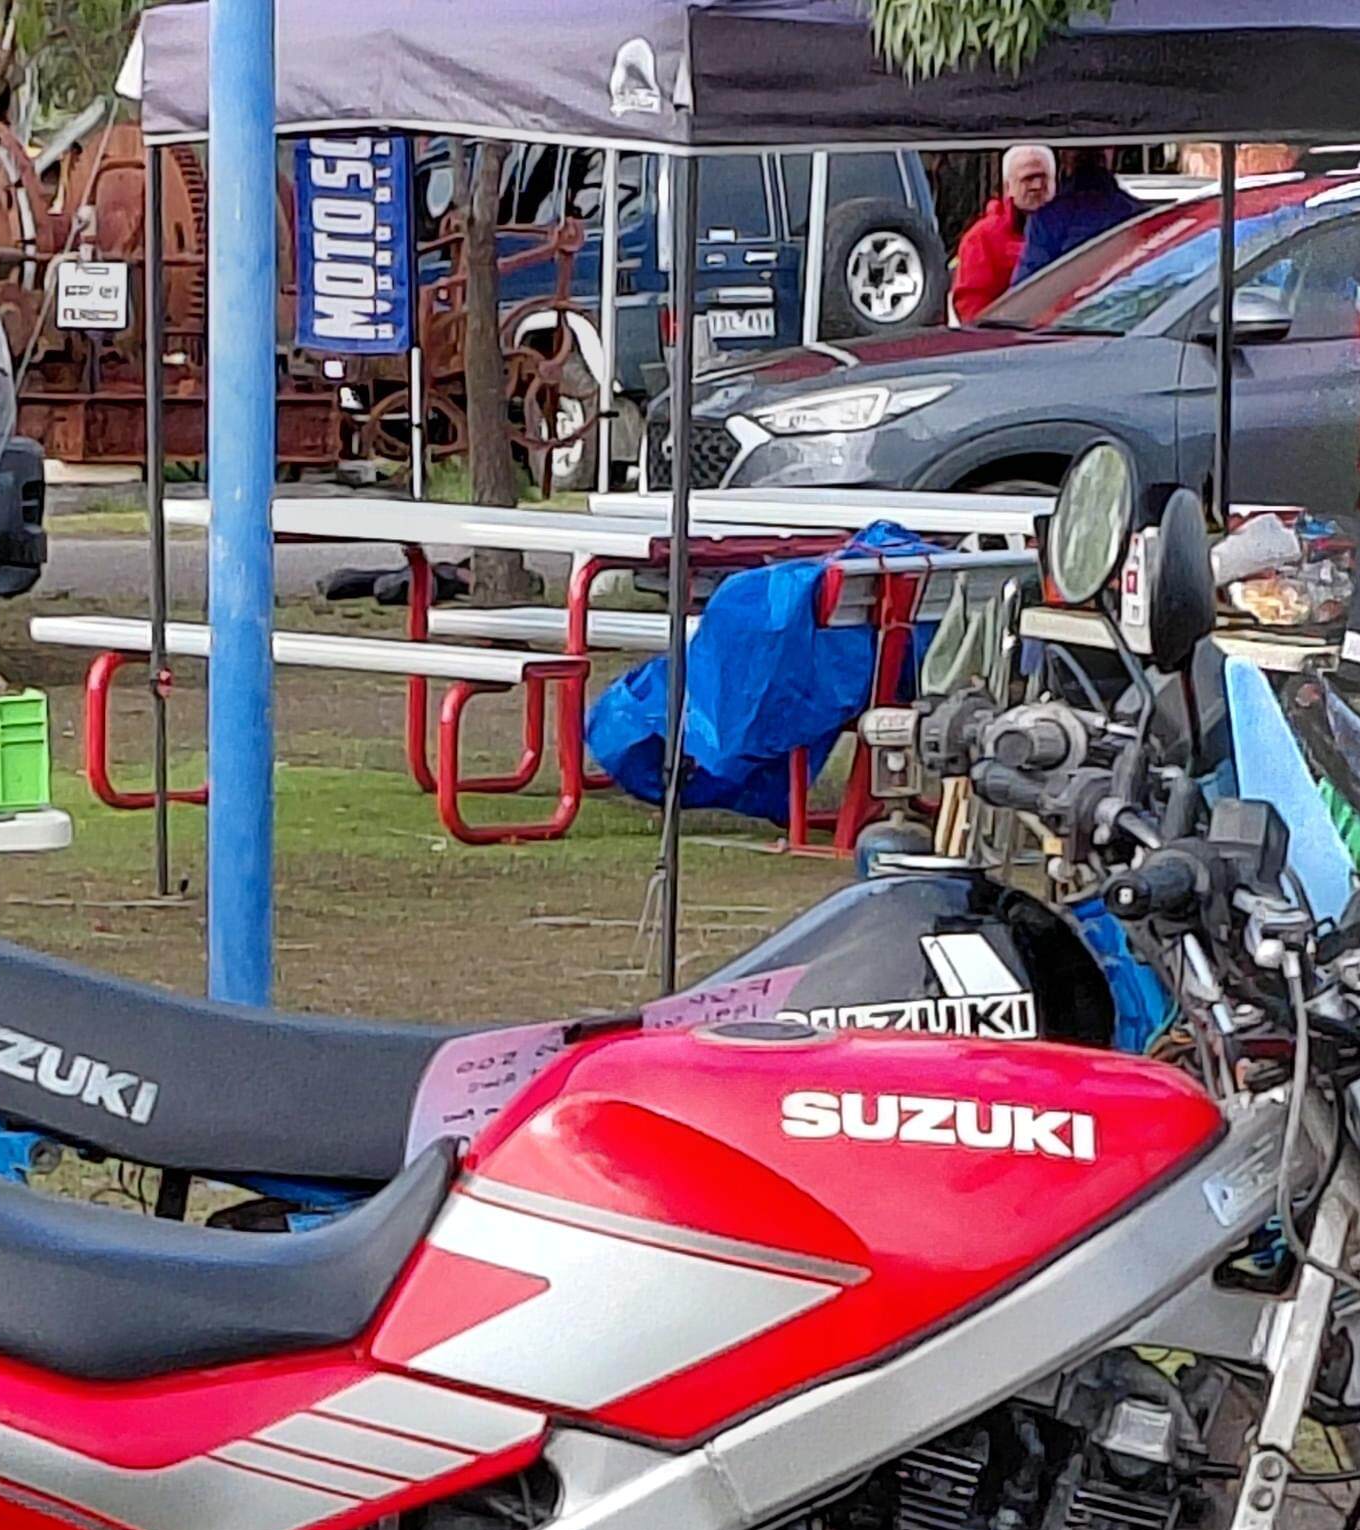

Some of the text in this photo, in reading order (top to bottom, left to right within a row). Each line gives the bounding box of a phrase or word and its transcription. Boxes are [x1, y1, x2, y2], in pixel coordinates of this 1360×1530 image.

[312, 196, 377, 341] MOTO
[775, 993, 1037, 1039] ZUKI
[781, 1090, 1097, 1161] SUZUKI
